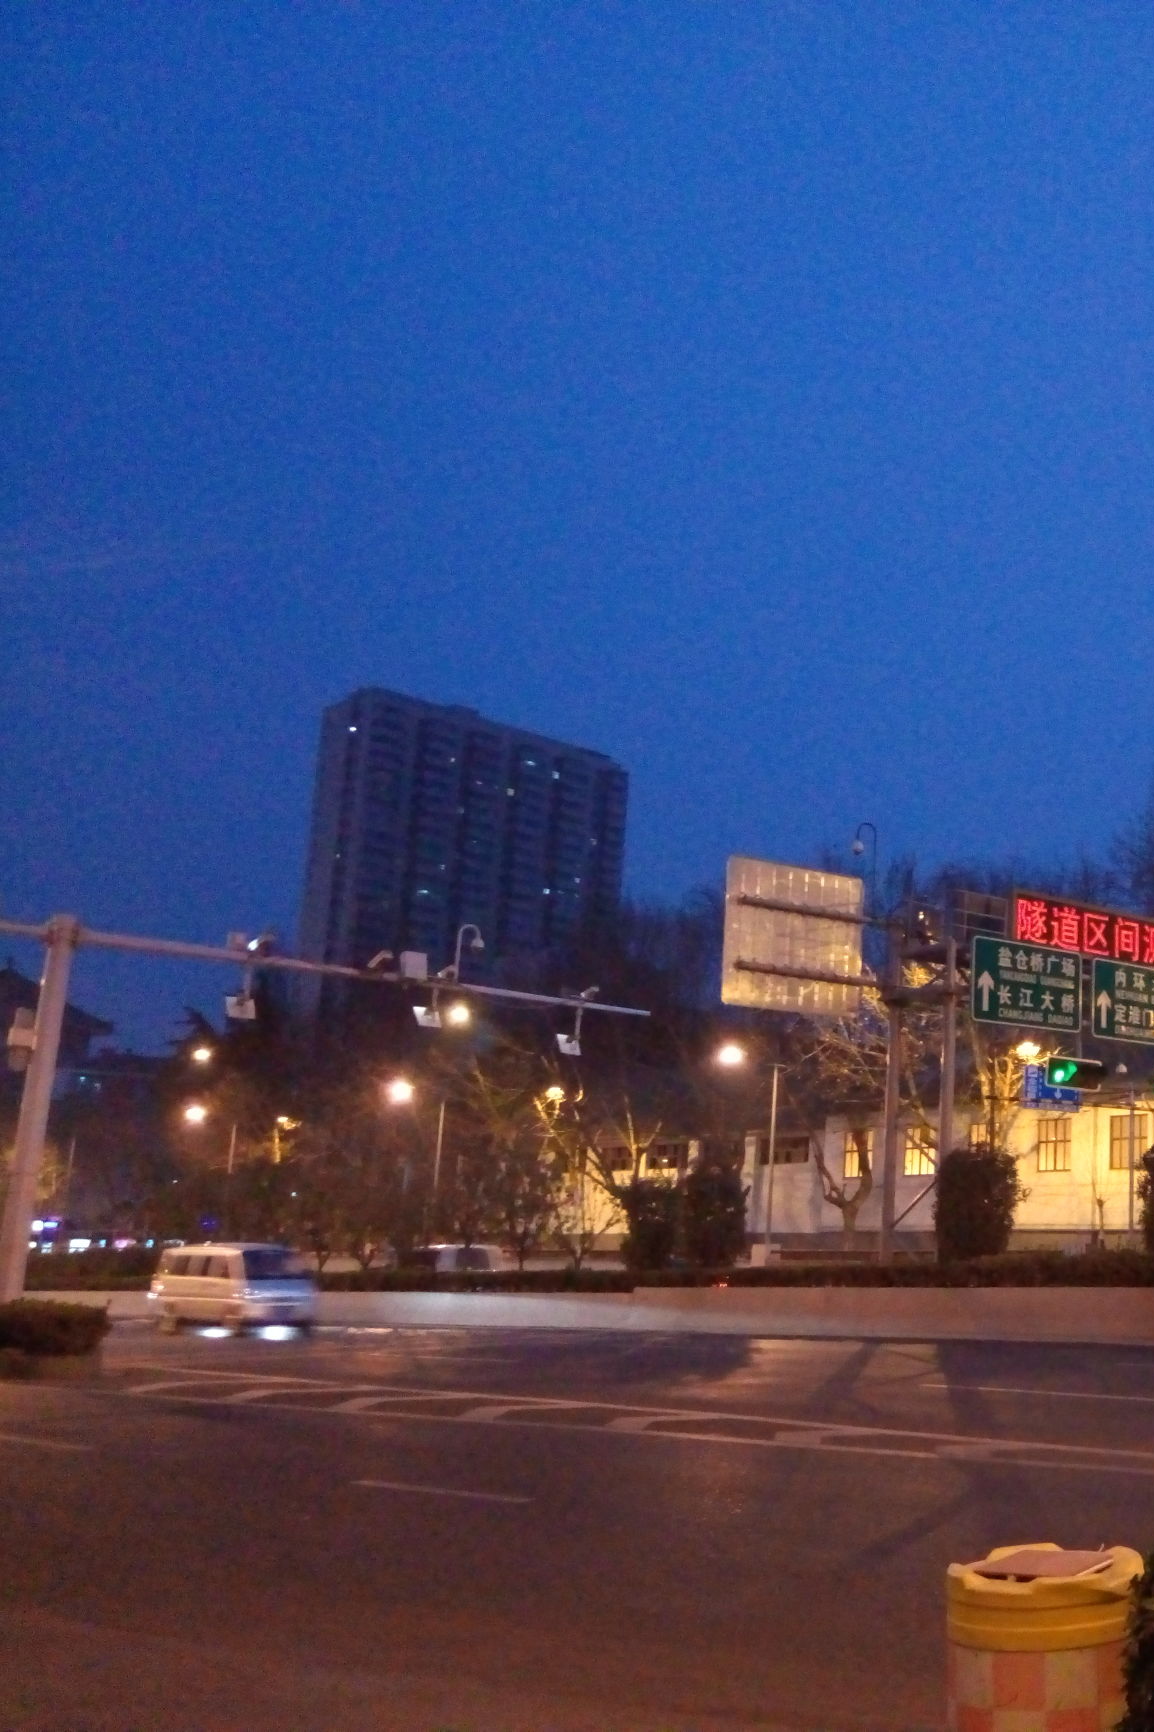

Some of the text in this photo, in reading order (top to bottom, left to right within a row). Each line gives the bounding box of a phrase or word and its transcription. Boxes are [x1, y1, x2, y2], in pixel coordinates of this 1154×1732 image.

[998, 946, 1076, 977] 盐仓桥广场
[997, 984, 1075, 1013] 长江大桥
